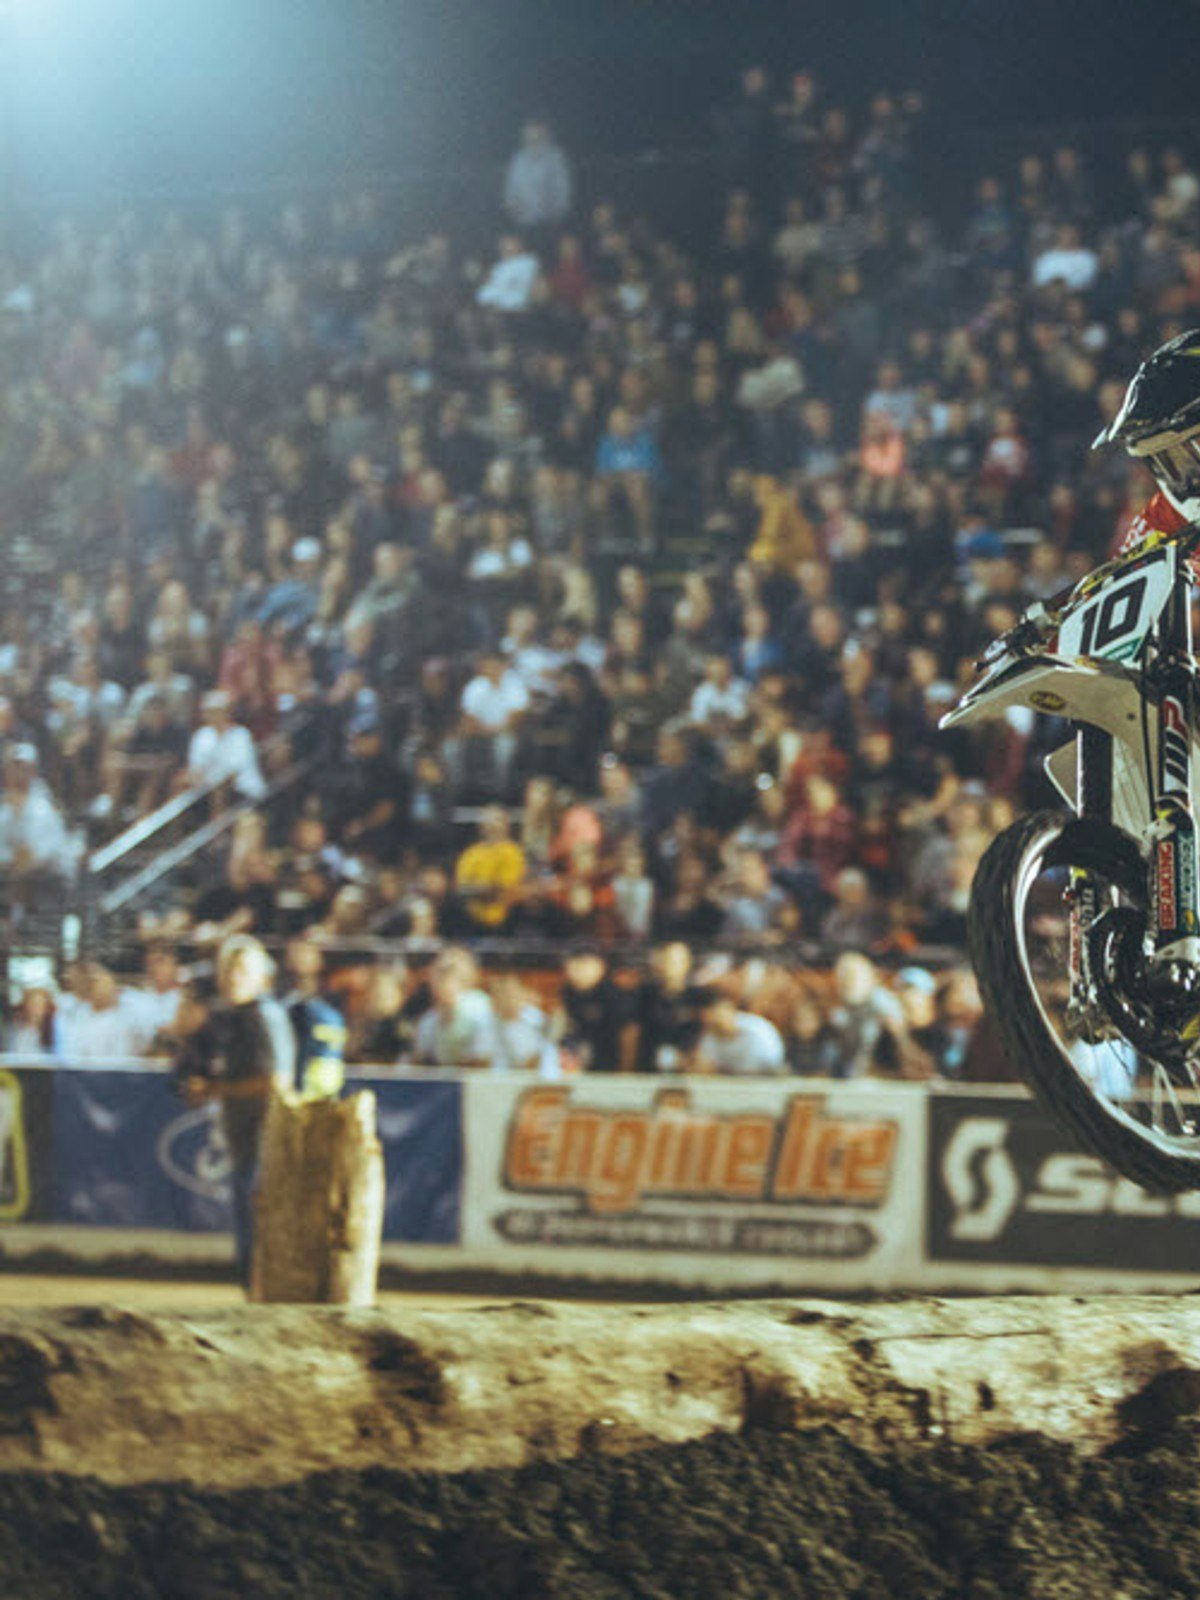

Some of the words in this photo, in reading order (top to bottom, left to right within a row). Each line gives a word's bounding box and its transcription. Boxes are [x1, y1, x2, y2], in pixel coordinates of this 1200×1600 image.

[1079, 577, 1147, 655] 10
[1159, 842, 1176, 928] BRAKING
[500, 1086, 777, 1211] Engine
[767, 1093, 900, 1206] Ice
